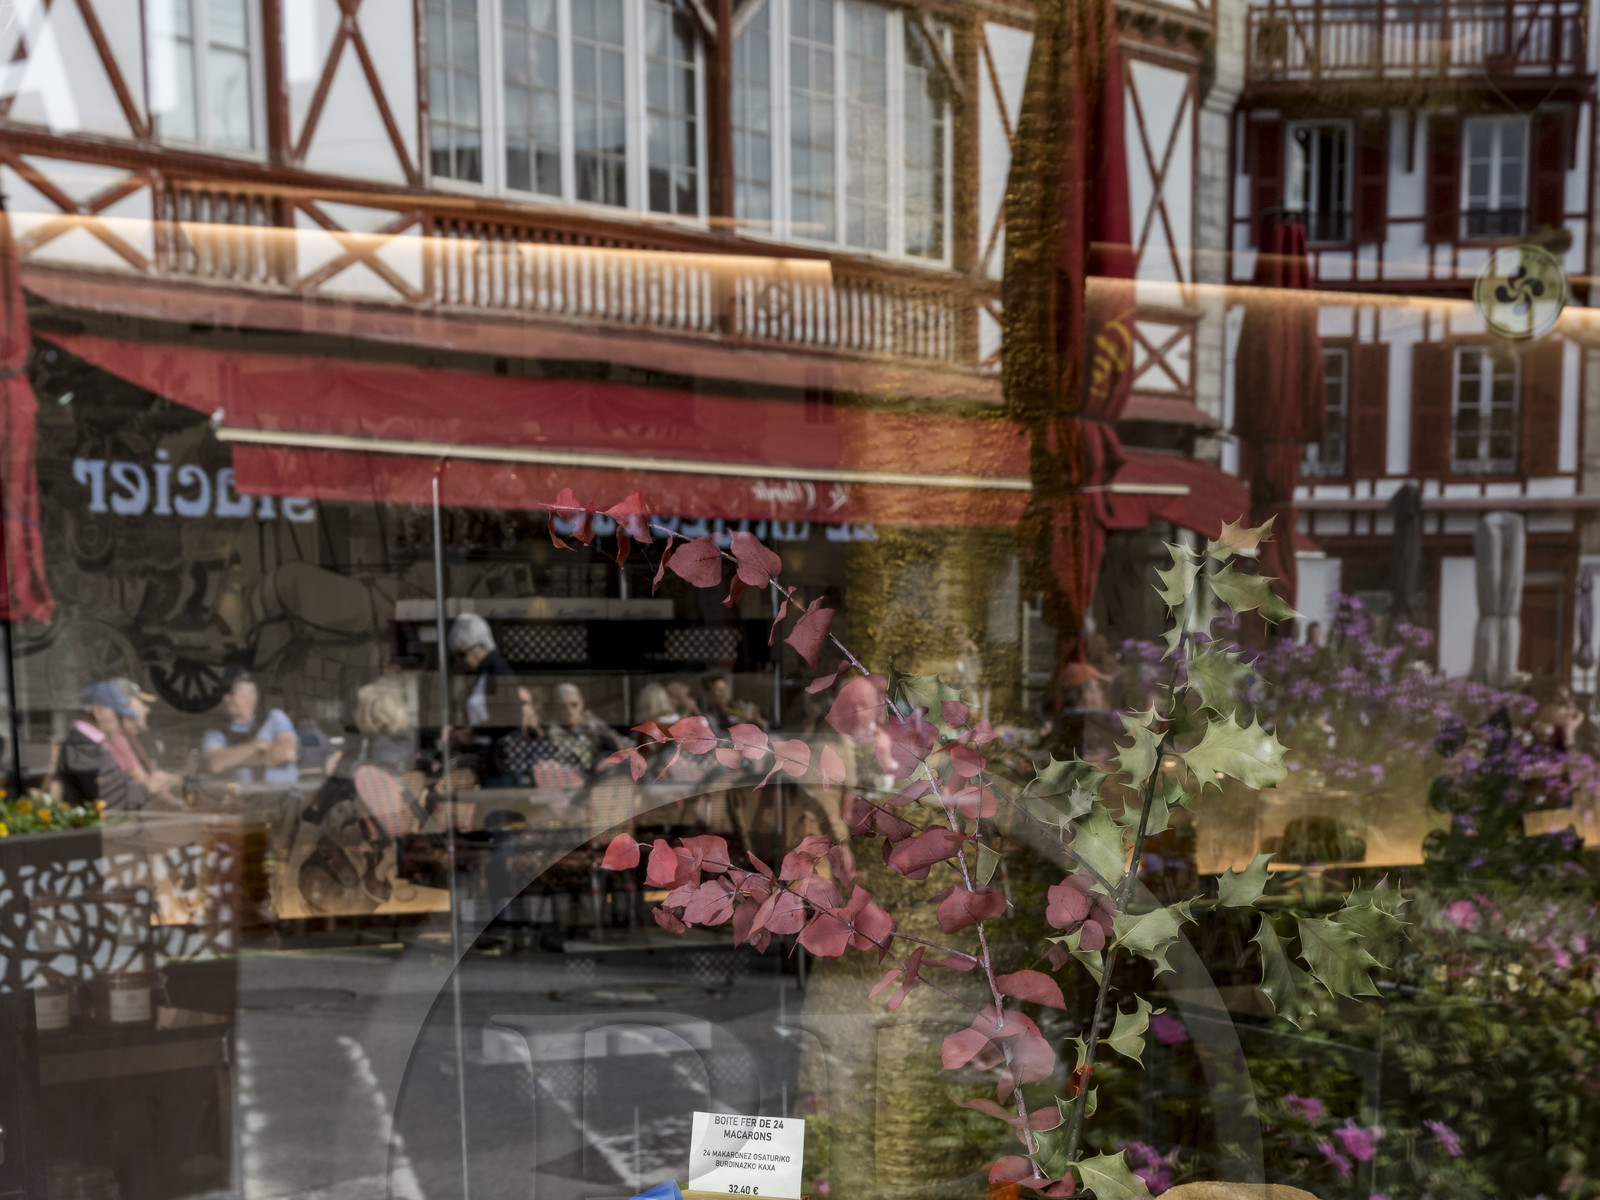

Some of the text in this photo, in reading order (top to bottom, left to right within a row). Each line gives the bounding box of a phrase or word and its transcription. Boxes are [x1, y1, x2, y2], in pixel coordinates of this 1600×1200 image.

[715, 1116, 784, 1130] BOITE FER DE 24
[724, 1129, 772, 1142] MACARONS
[712, 1150, 752, 1160] MAKARONEZ
[753, 1153, 791, 1163] OSATURIKO
[716, 1160, 776, 1172] BURDINAZKO KAXA
[728, 1185, 759, 1196] 32.40 €
